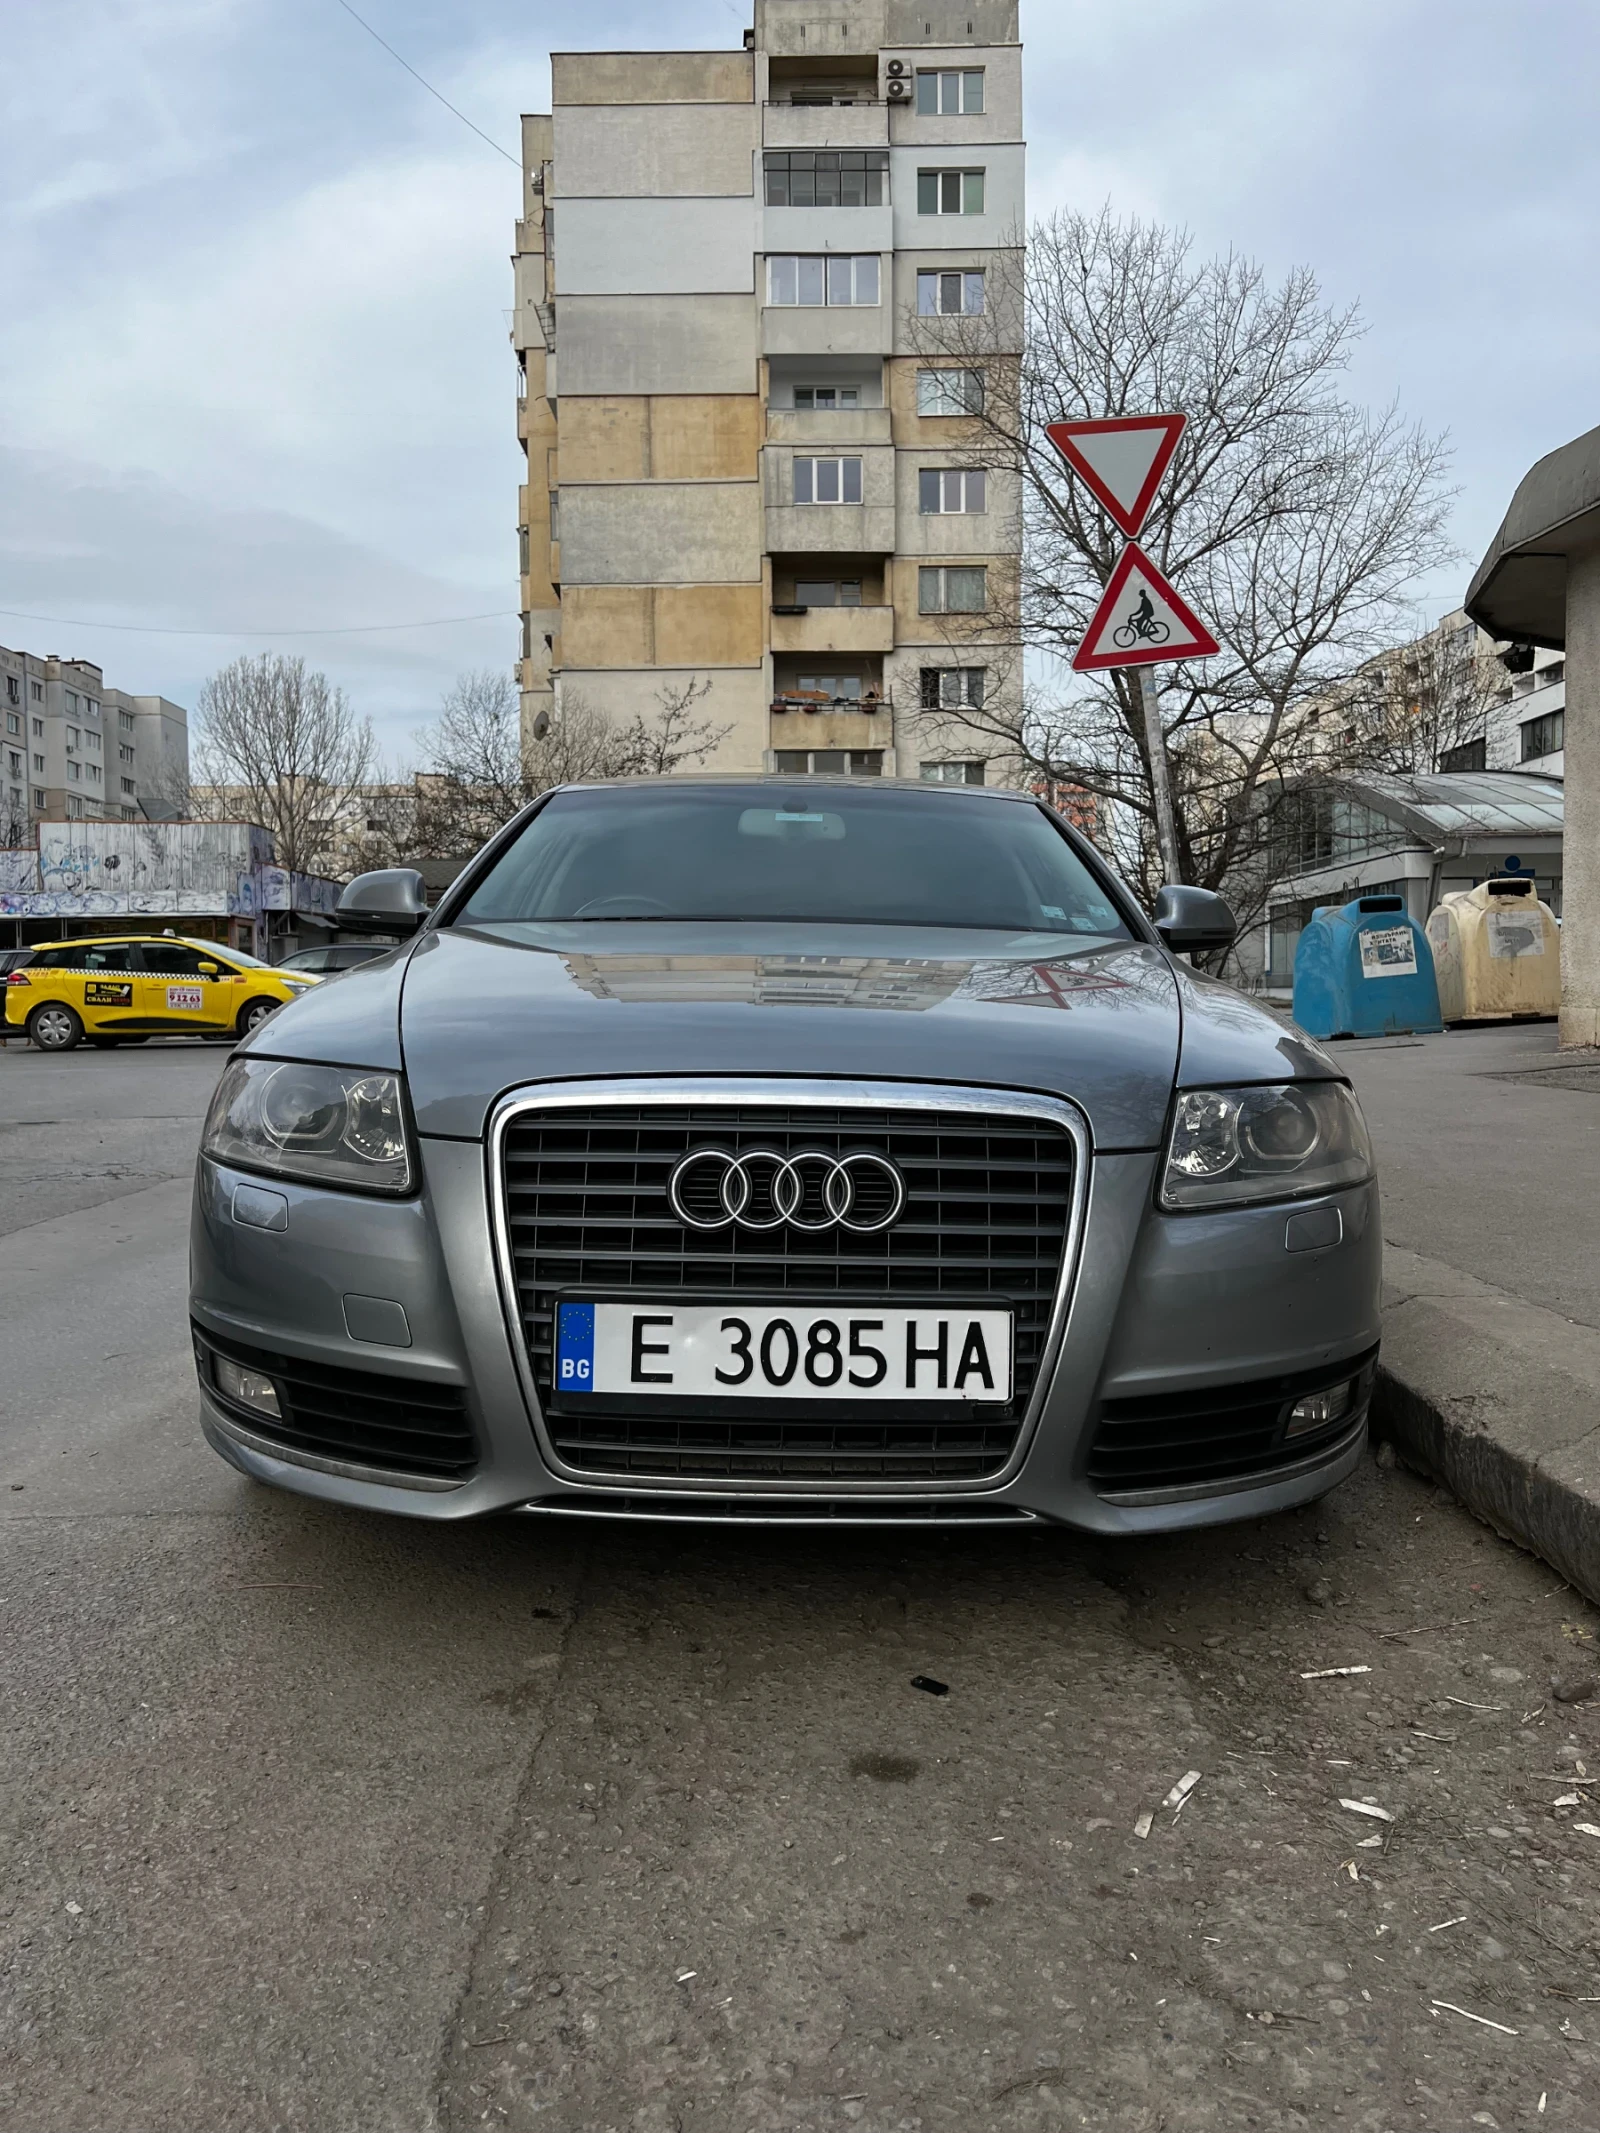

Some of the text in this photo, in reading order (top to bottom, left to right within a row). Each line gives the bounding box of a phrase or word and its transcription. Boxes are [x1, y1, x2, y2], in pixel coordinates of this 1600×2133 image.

[561, 1358, 590, 1379] BG
[631, 1315, 995, 1389] E 3085 HA
